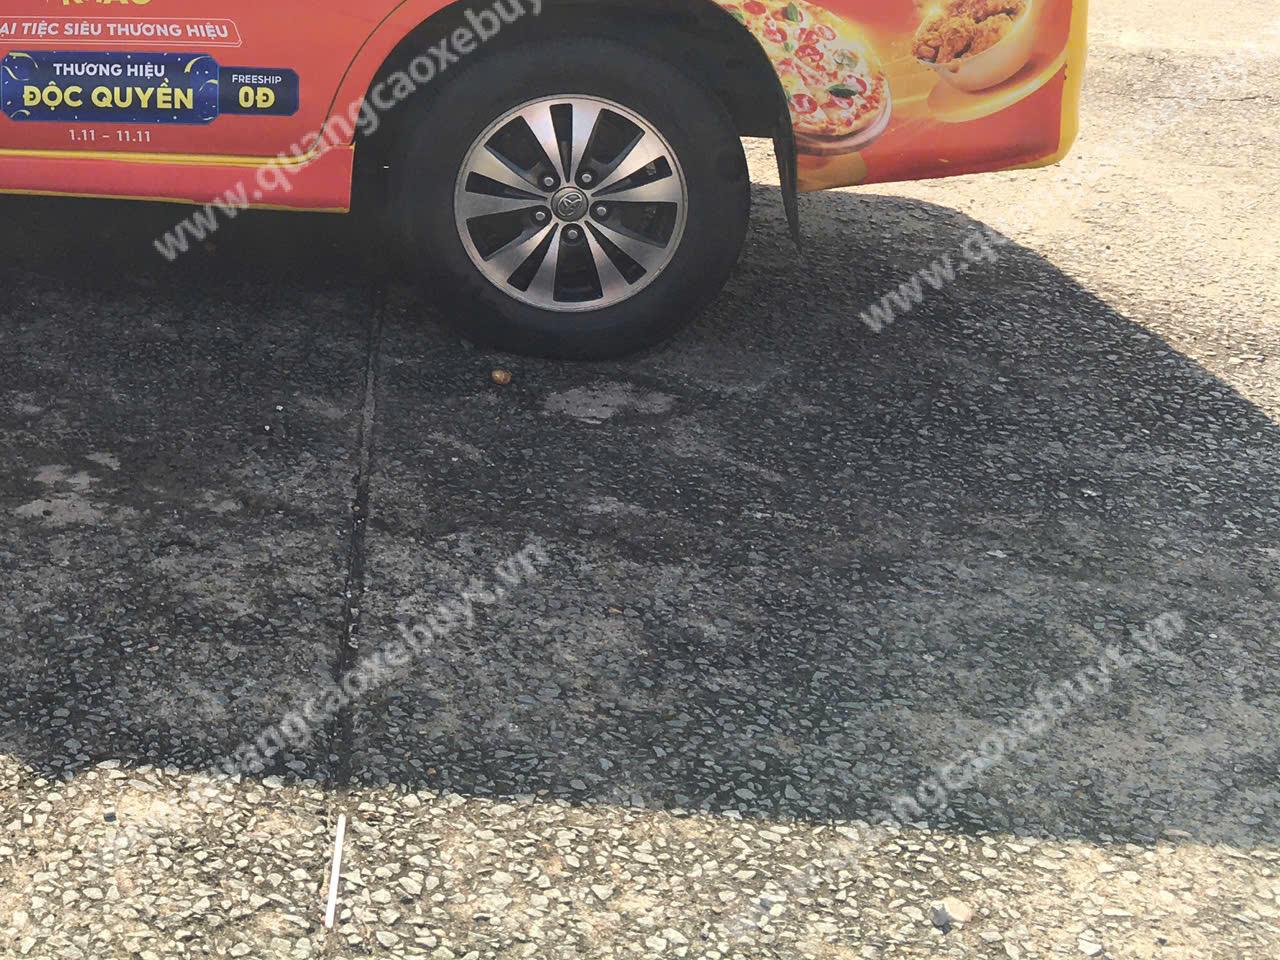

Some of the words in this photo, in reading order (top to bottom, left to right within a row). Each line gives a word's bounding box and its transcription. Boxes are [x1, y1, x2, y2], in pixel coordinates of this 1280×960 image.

[21, 19, 59, 37] TIỆC
[64, 19, 102, 37] SIÊU
[107, 22, 181, 38] THƯƠNG
[186, 22, 229, 39] HIỆU
[53, 62, 123, 77] THƯƠNG
[127, 61, 166, 79] HIỆU
[231, 74, 283, 86] FREESHIP
[22, 80, 83, 112] ĐỘC
[90, 77, 194, 110] QUYỀN
[237, 85, 276, 109] 0Đ
[68, 129, 96, 142] 1.11
[116, 129, 152, 143] 11.11
